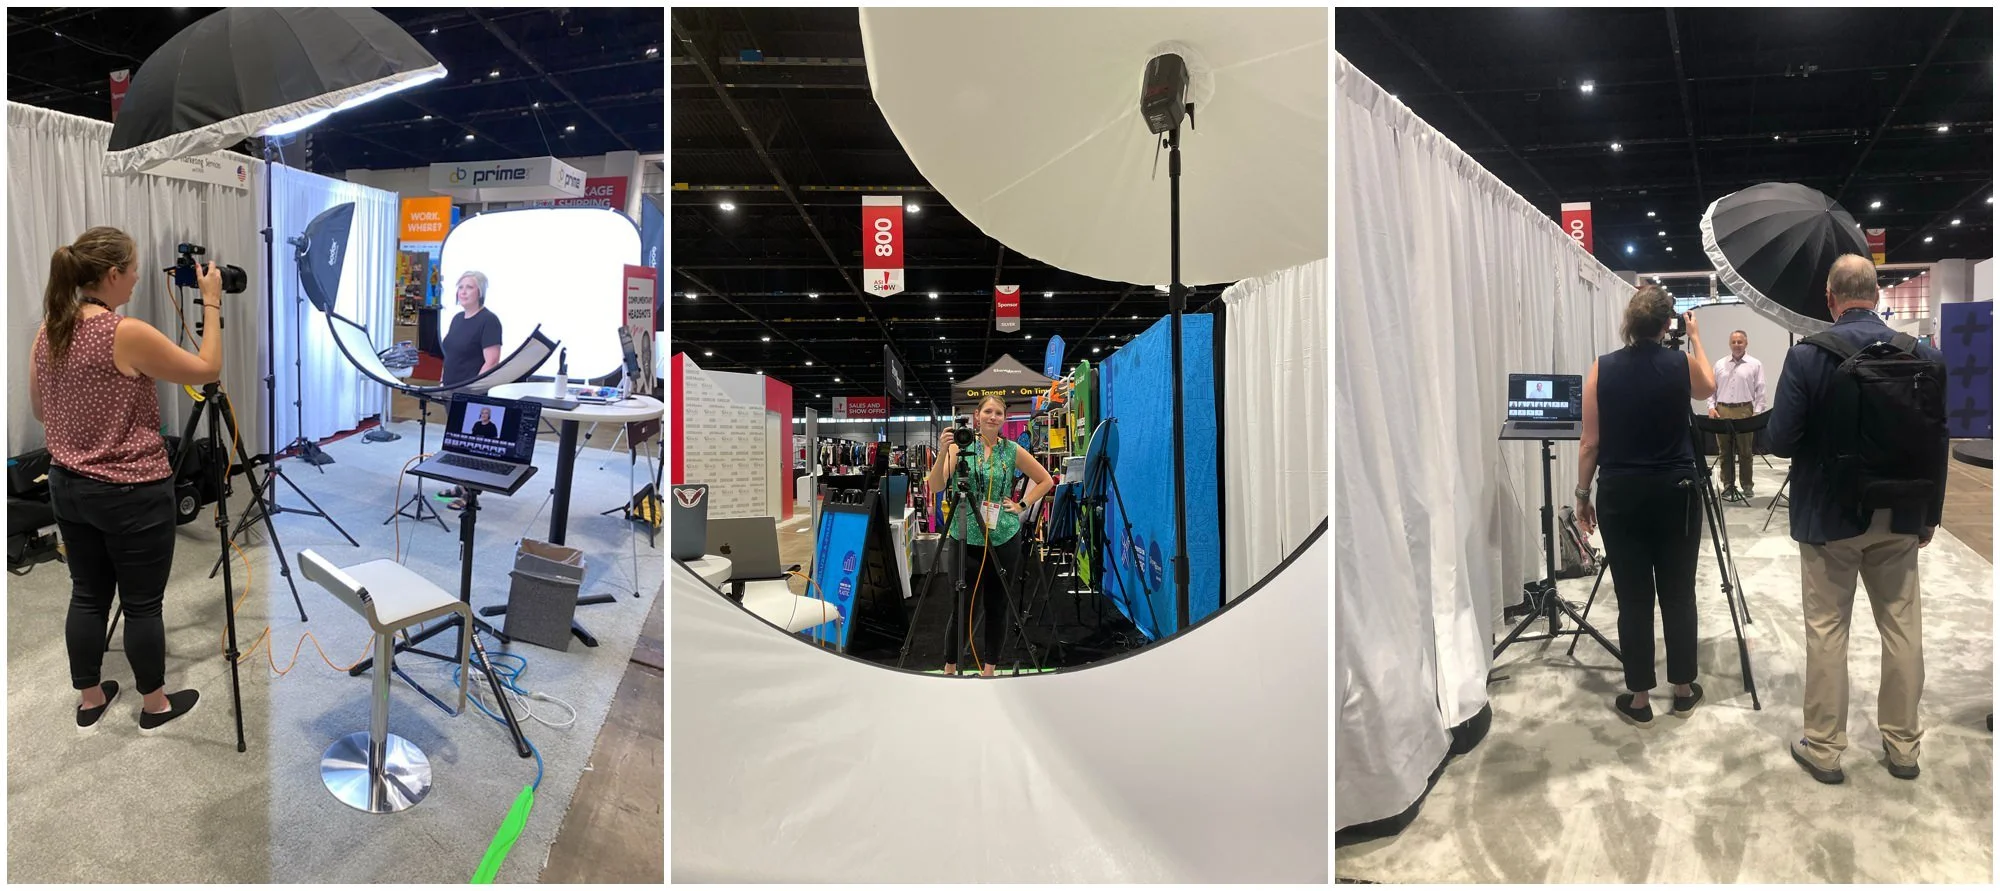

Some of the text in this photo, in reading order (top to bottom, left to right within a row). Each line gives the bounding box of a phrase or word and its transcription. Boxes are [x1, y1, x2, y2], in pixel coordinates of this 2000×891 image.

[181, 156, 204, 168] arketing
[473, 165, 526, 185] prime
[408, 222, 443, 232] WHERE?
[874, 217, 893, 257] 800
[967, 389, 979, 397] On
